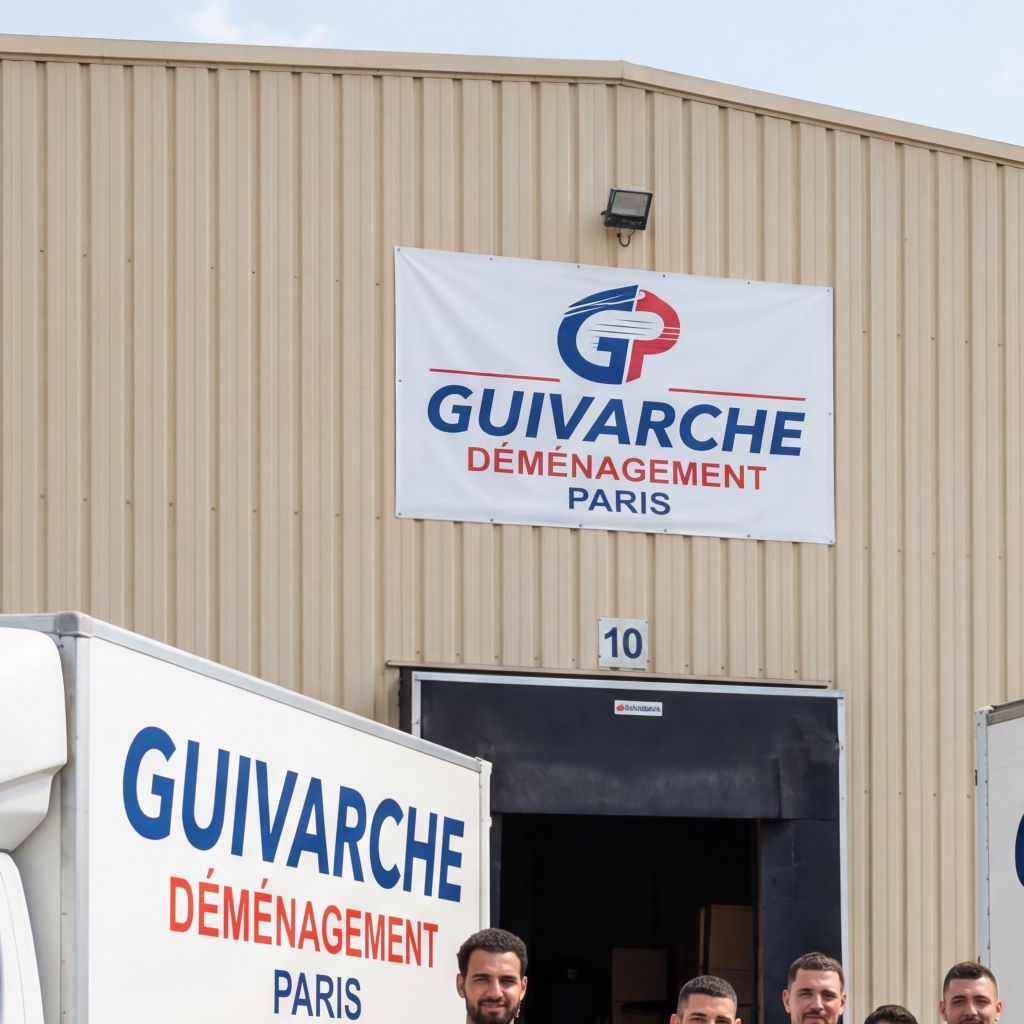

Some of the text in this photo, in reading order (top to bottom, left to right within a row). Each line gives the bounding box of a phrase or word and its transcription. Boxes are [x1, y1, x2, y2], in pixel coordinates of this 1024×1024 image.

[427, 384, 806, 457] GUIVARCHE
[467, 441, 767, 490] DÉMÉNAGEMENT
[568, 486, 671, 516] PARIS
[604, 626, 643, 660] 10
[122, 726, 466, 903] GUIVARCHE
[169, 867, 439, 968] DÉMÉNAGEMENT
[273, 969, 362, 1021] PARIS
